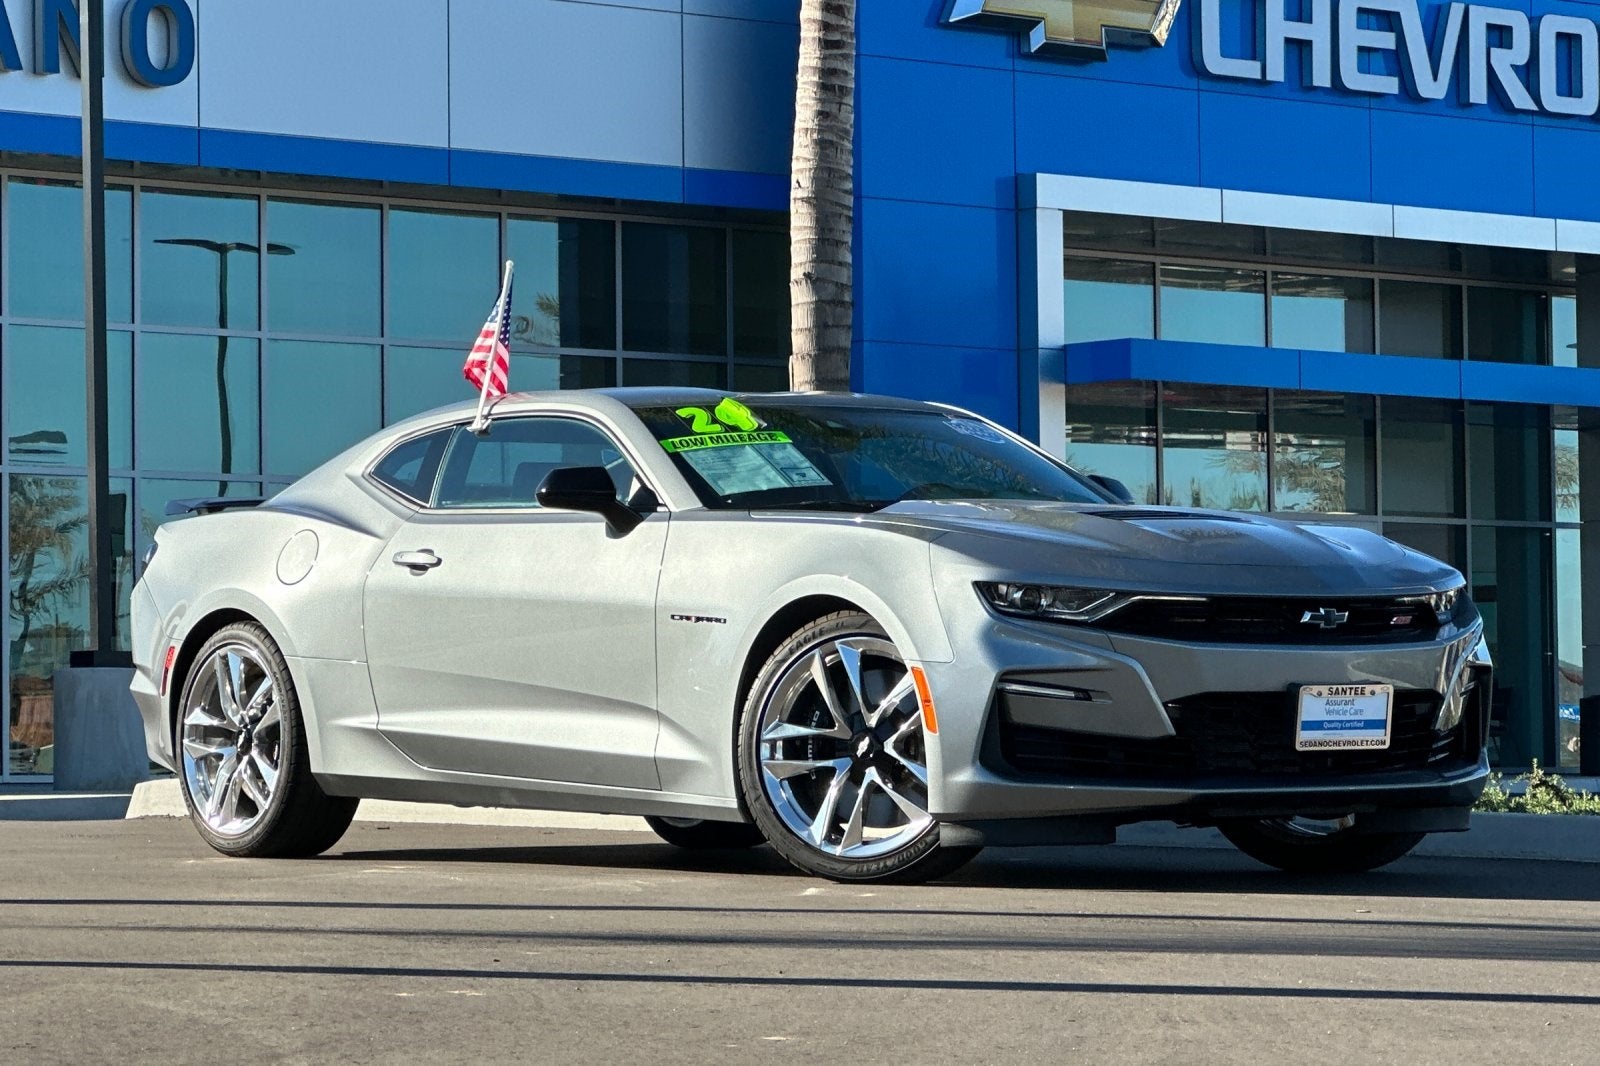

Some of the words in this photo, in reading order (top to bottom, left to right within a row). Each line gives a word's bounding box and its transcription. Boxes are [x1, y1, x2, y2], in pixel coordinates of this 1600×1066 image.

[1199, 0, 1599, 117] CHEVRO
[670, 436, 707, 450] LOW
[709, 431, 780, 446] MILEAGE
[1327, 686, 1367, 696] SANTEE
[1325, 698, 1356, 707] Assurant
[1325, 707, 1349, 717] Vehicle
[1349, 707, 1364, 716] Care
[1323, 721, 1341, 730] Quality
[1342, 720, 1364, 729] Certified
[1299, 739, 1387, 748] SEDANOCHEVROLET.COM
